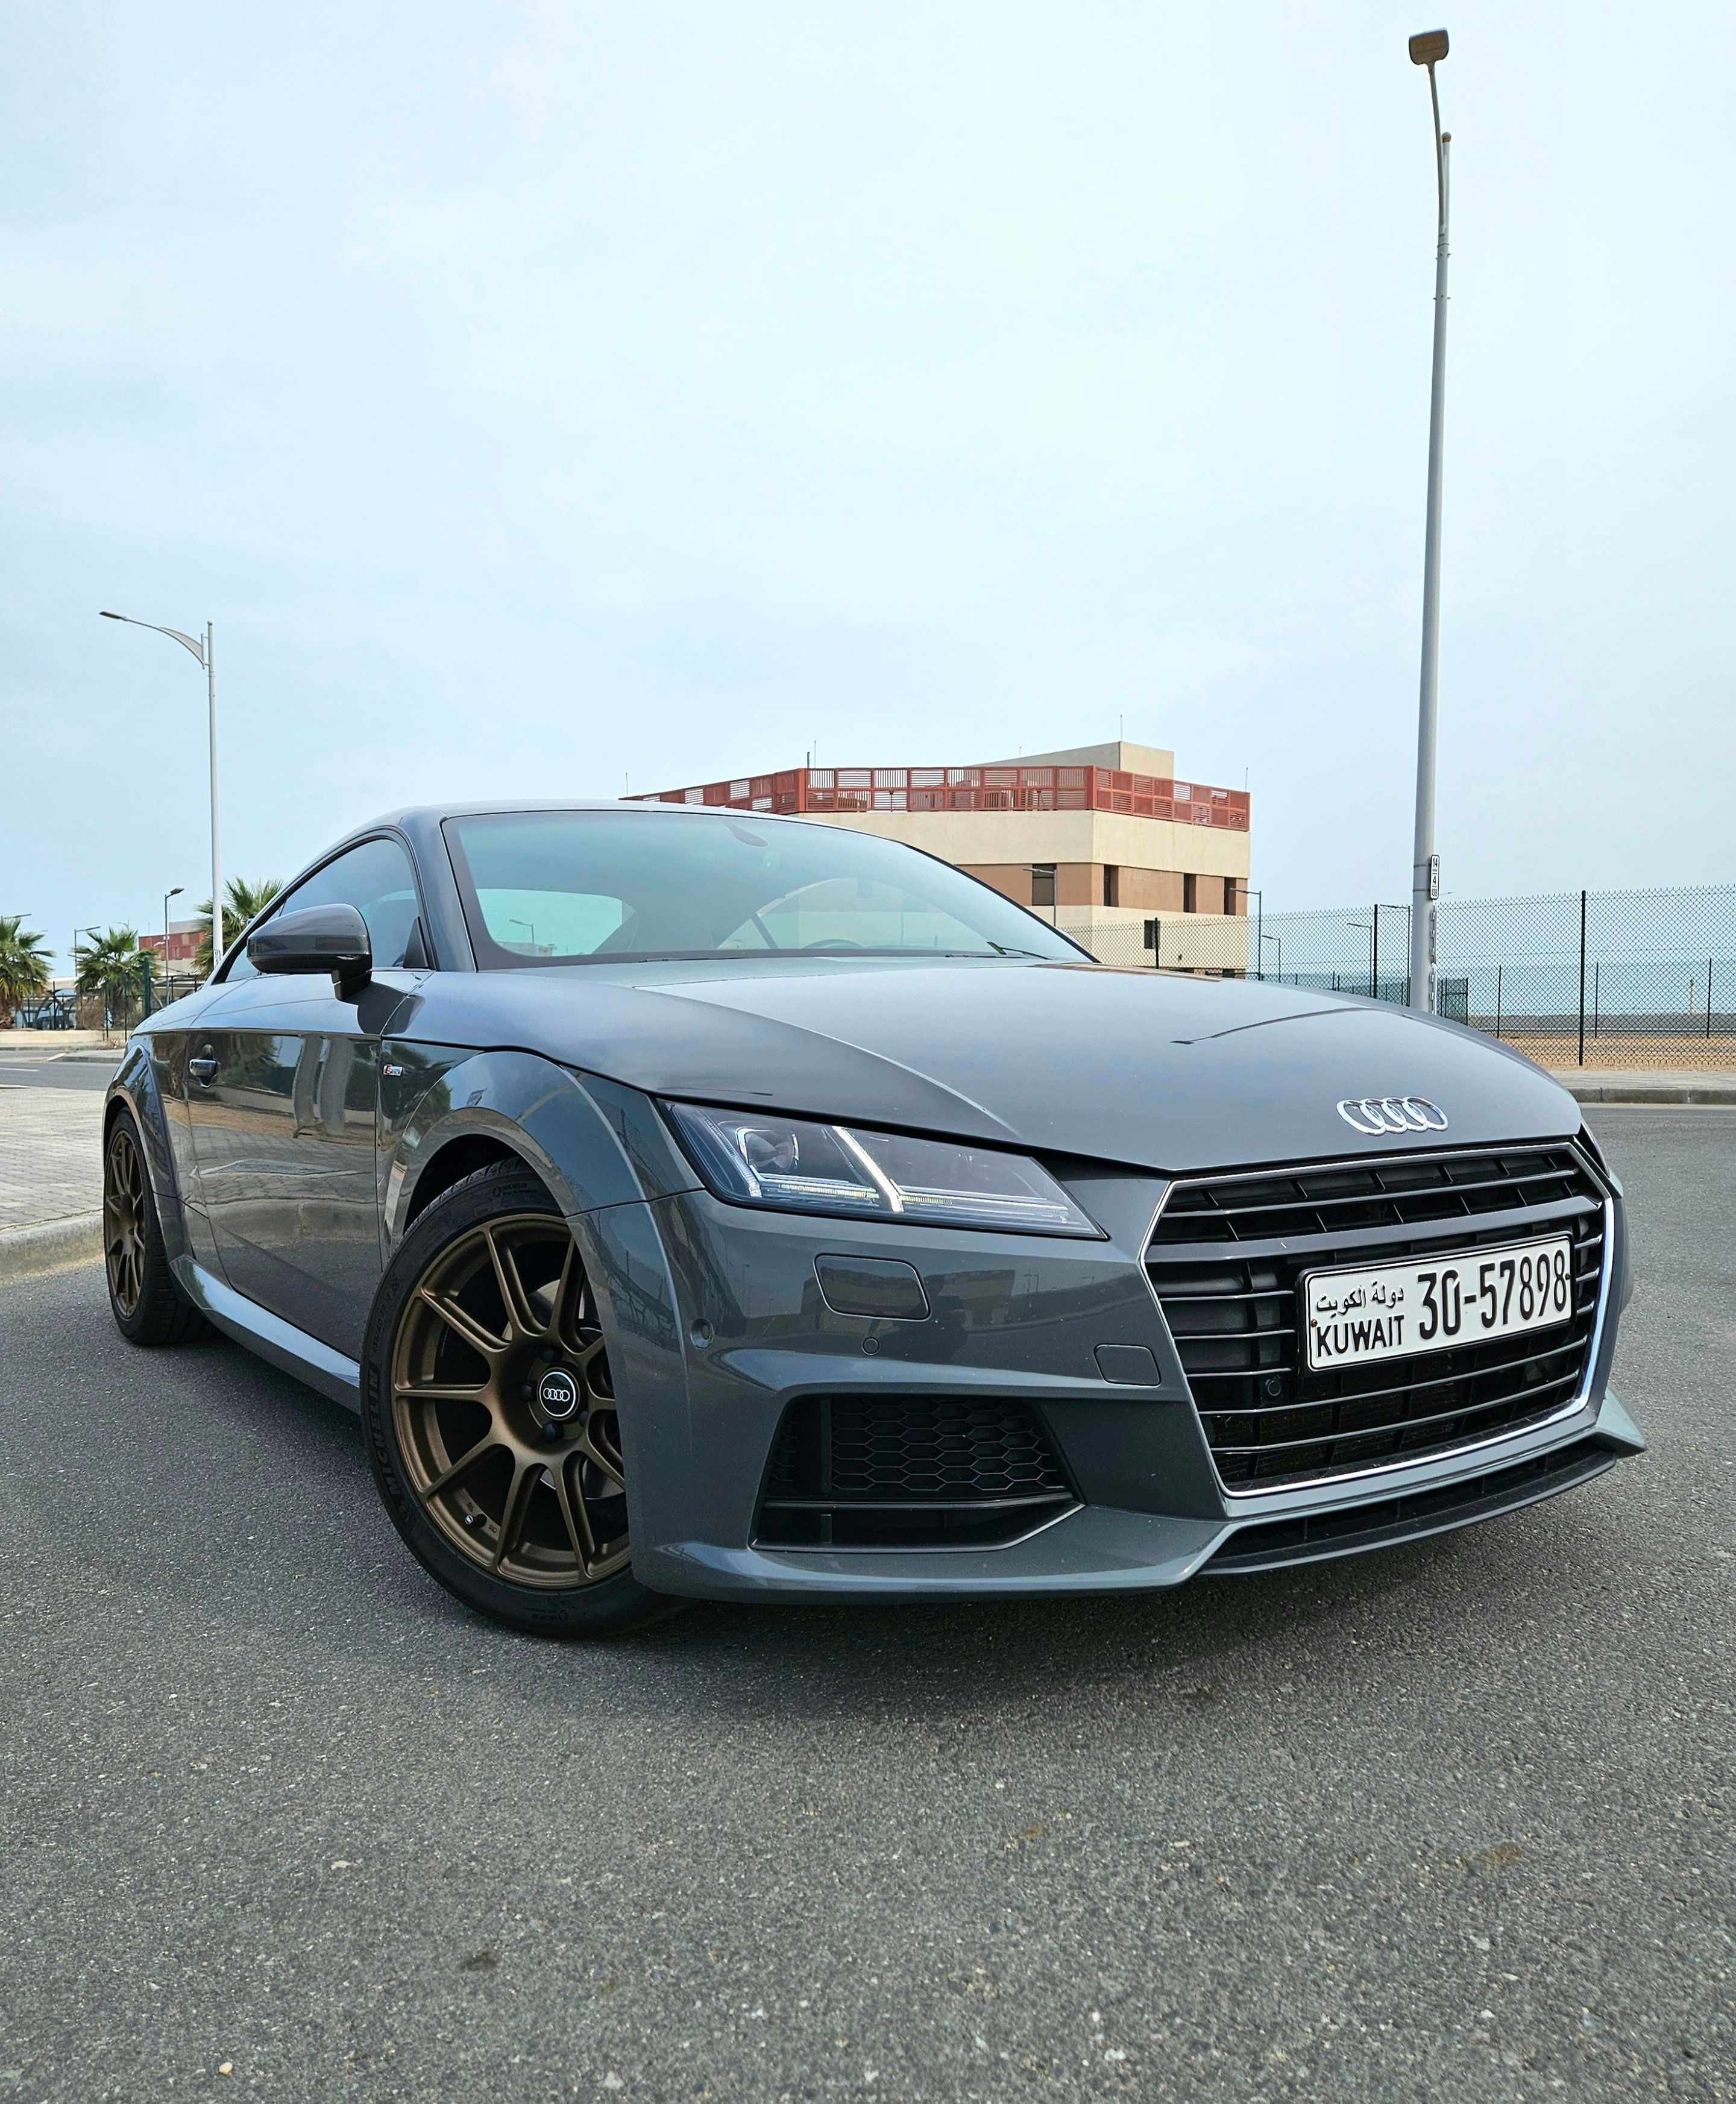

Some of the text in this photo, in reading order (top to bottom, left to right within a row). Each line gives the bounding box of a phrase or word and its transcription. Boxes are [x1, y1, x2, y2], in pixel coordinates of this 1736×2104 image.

[1433, 857, 1438, 868] 14
[1433, 875, 1436, 885] 4
[1316, 1280, 1404, 1319] دولة الكويت
[1417, 1249, 1567, 1340] 30-57898
[1316, 1314, 1405, 1357] KUWAIT
[369, 1369, 401, 1495] MICHELIN
